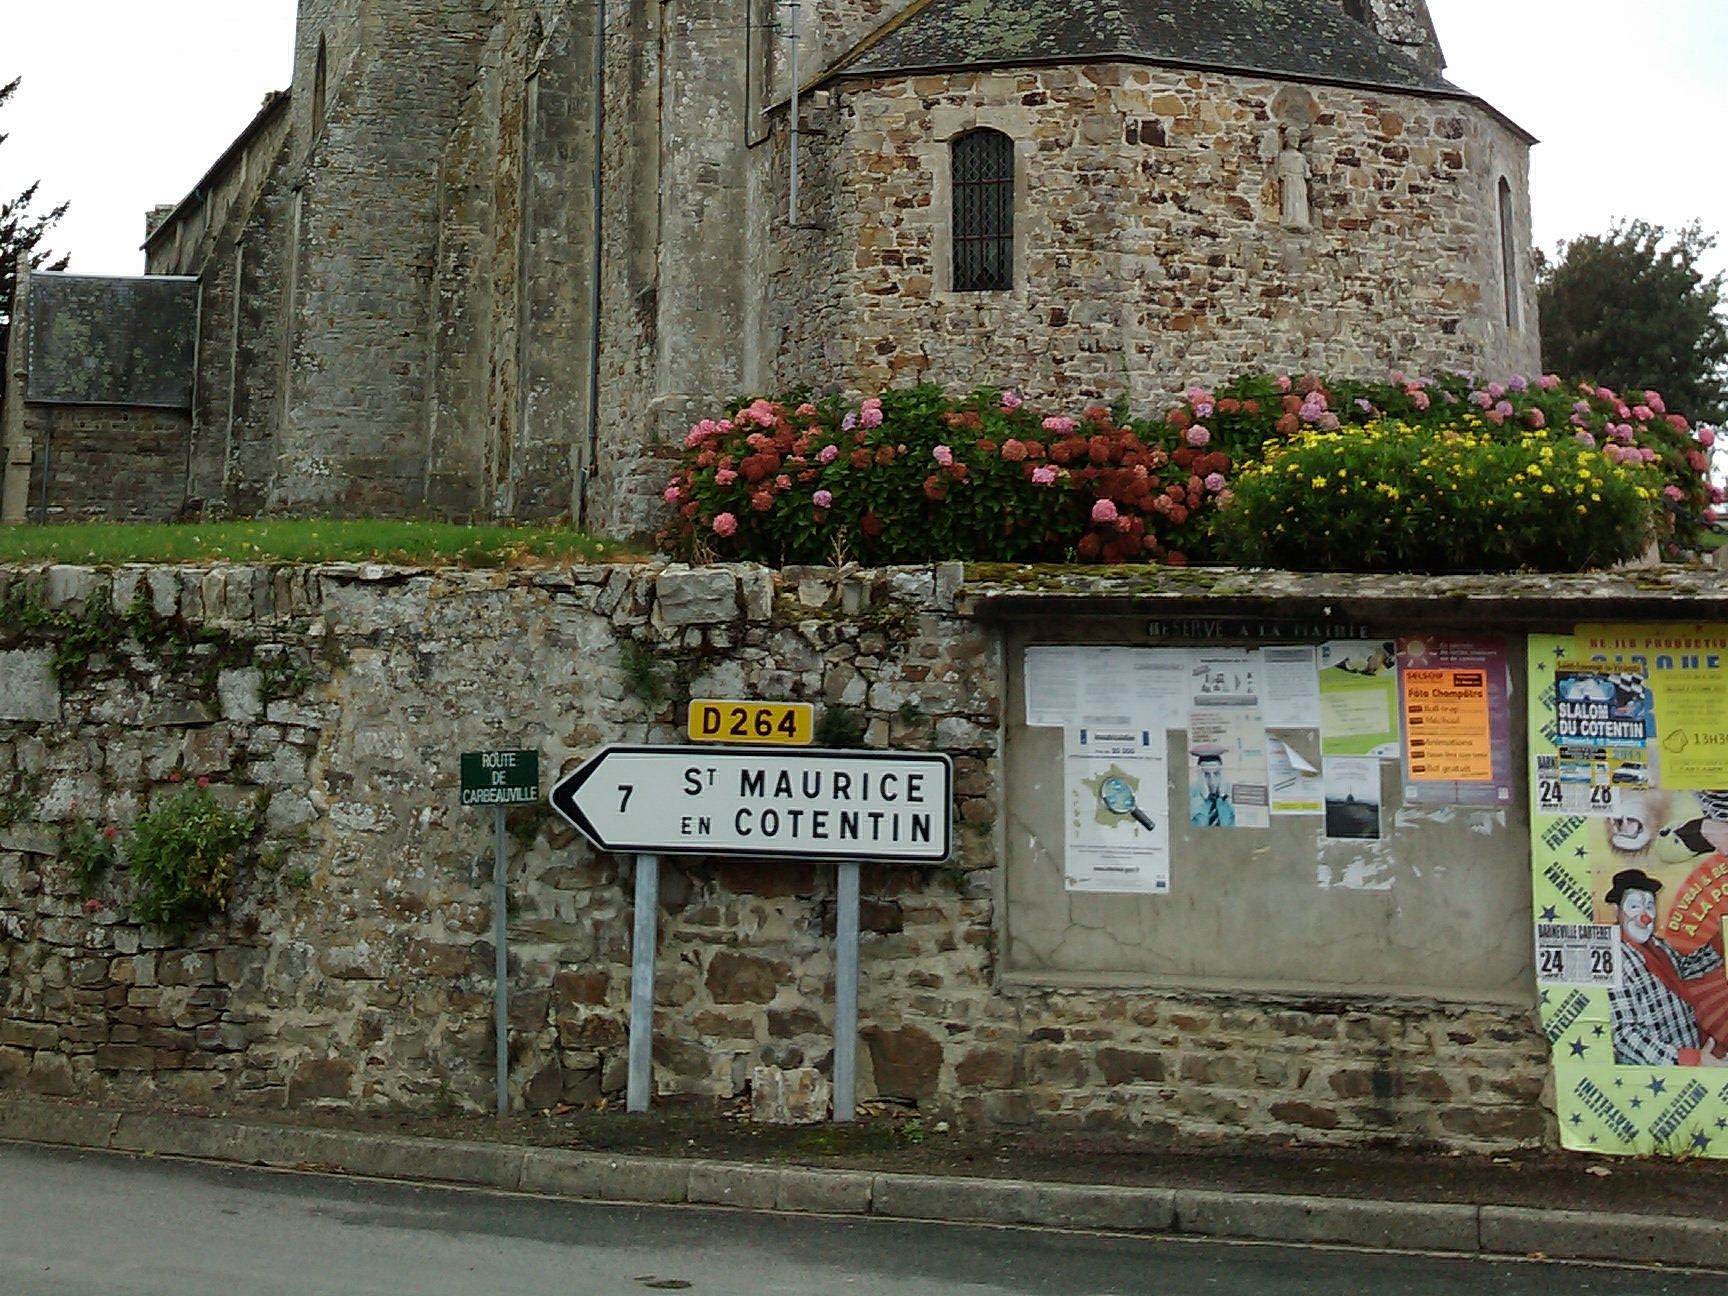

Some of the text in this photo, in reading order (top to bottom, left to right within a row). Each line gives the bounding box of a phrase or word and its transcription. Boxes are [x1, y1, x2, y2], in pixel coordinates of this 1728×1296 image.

[1558, 703, 1609, 719] SLALOM
[1559, 720, 1576, 735] DU
[1579, 721, 1644, 738] COTENTIN
[482, 752, 516, 768] ROUTE
[492, 770, 506, 785] DE
[740, 768, 924, 802] MAURICE
[463, 786, 537, 804] CARBEAUVILLE
[618, 784, 633, 813] 7
[1540, 780, 1563, 802] 24
[681, 808, 930, 842] EN COTENTIN
[1545, 814, 1588, 851] FRATEL
[1668, 913, 1683, 932] DU
[1679, 882, 1702, 911] VRAI
[1692, 900, 1713, 923] LA
[1538, 924, 1612, 940] BARNEVILLE CARTERET
[1540, 950, 1564, 972] 24
[1591, 950, 1614, 974] 28
[1578, 1076, 1640, 1140] FRATELLINI
